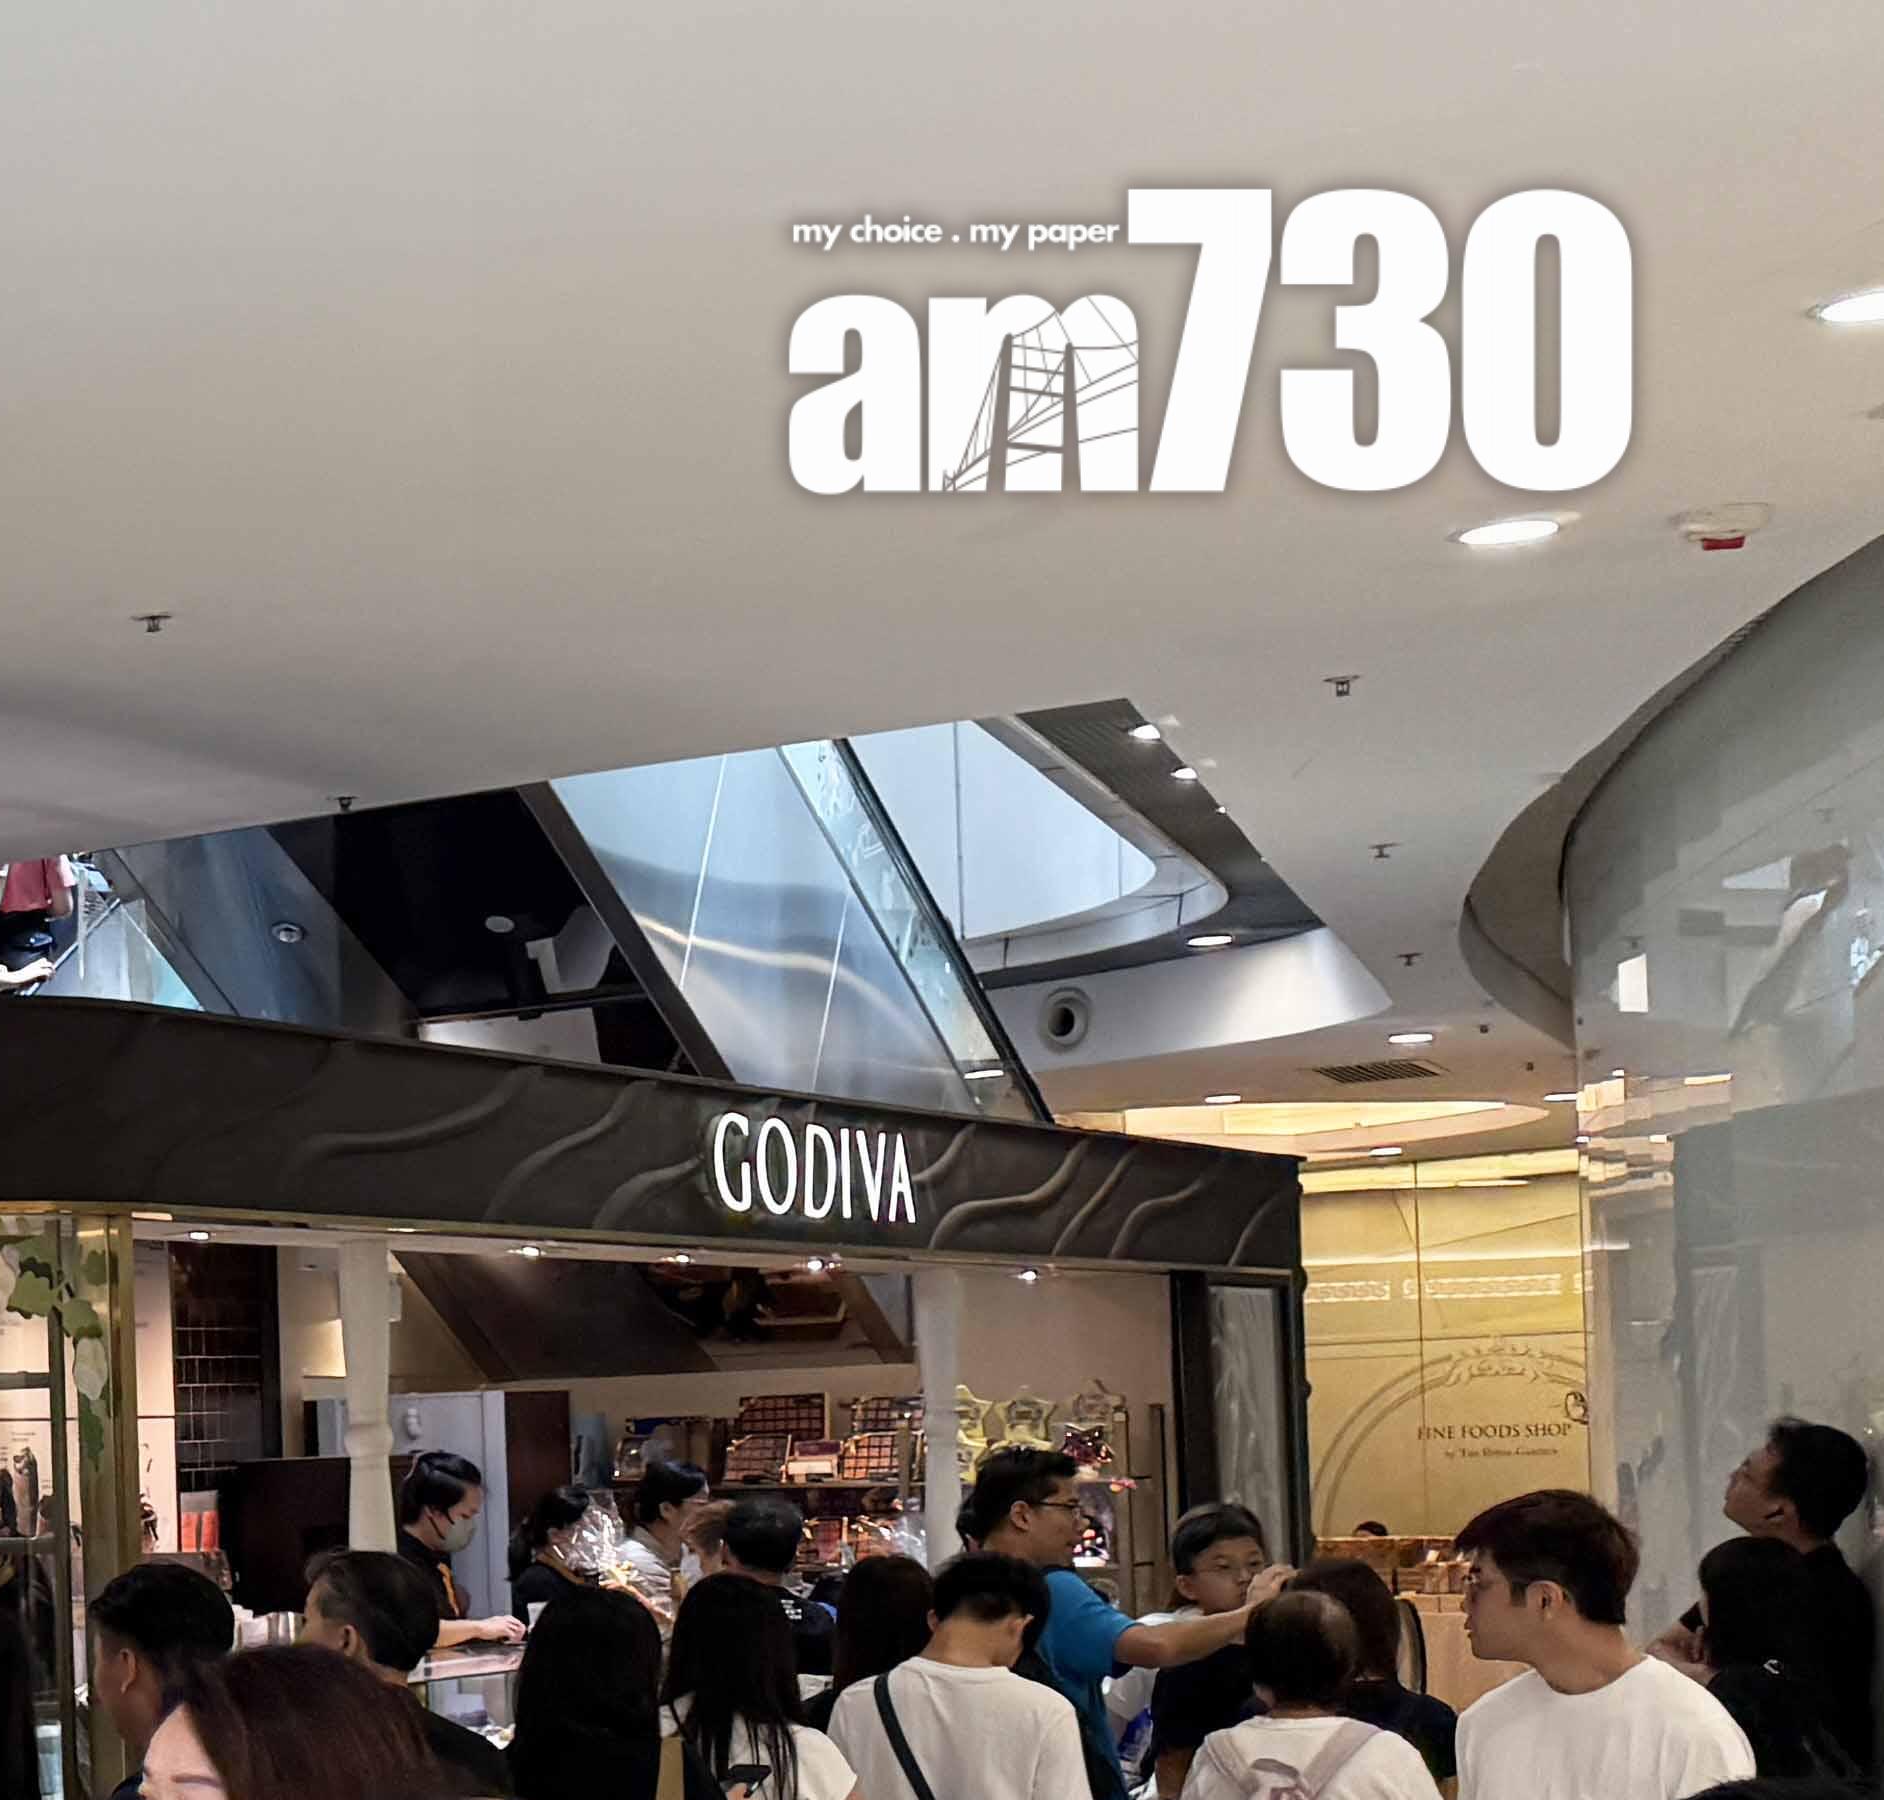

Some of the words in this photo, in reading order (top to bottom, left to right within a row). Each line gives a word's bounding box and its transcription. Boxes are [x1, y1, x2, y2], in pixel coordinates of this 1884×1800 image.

[712, 1111, 917, 1225] GODIVA
[1418, 1425, 1456, 1440] FINE
[1461, 1424, 1520, 1439] FOODS
[1525, 1423, 1572, 1438] SHOP
